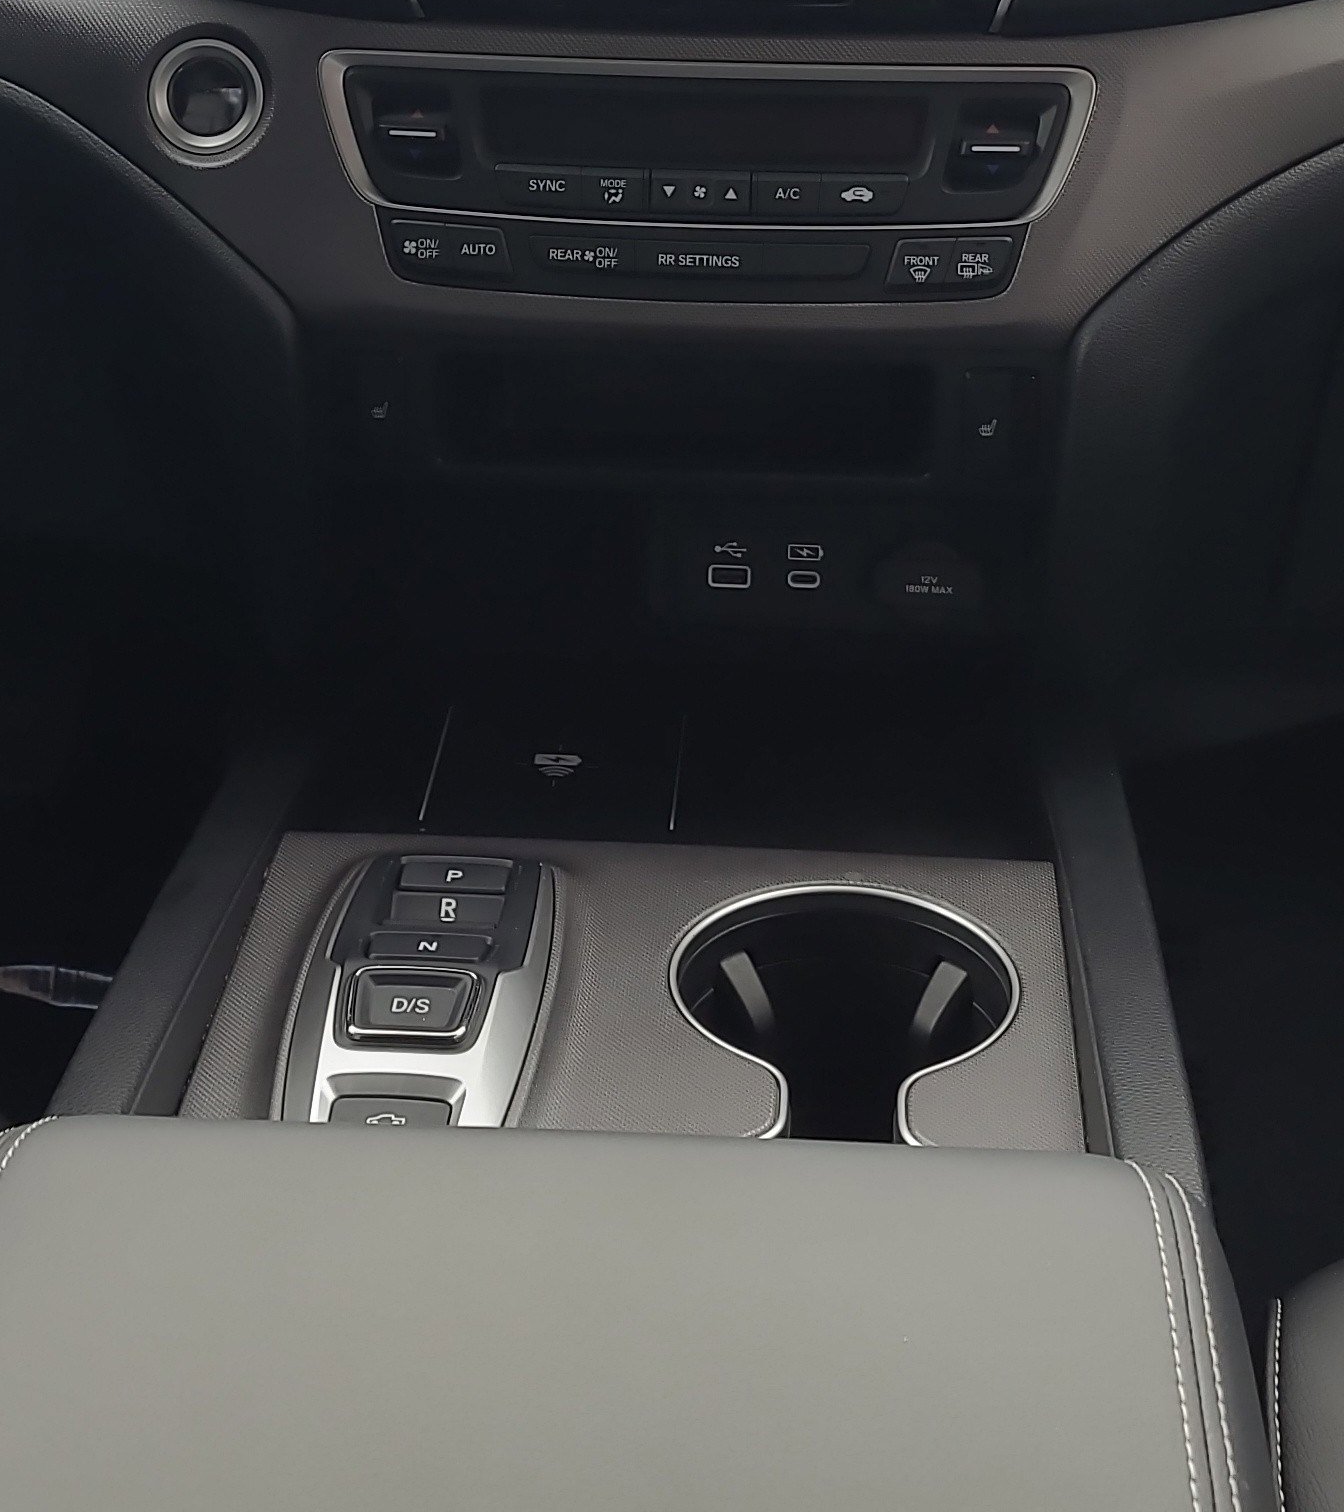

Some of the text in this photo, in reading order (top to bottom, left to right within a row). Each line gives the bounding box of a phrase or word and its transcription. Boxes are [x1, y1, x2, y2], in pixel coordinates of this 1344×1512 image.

[528, 179, 566, 192] SYNC
[600, 179, 627, 188] MODE
[775, 188, 800, 199] A/C
[418, 239, 439, 249] ON/
[418, 249, 440, 259] OFF
[461, 244, 496, 256] AUTO
[549, 249, 582, 260] REAR
[596, 247, 618, 258] ON/
[596, 258, 618, 268] OFF
[658, 254, 740, 268] RR SETTINGS
[904, 256, 939, 266] FRONT
[962, 253, 988, 263] REAR
[921, 576, 938, 584] 12V
[931, 585, 953, 594] MAX
[446, 870, 463, 882] P
[440, 898, 457, 919] R
[418, 941, 438, 951] N
[391, 998, 430, 1014] D/S
